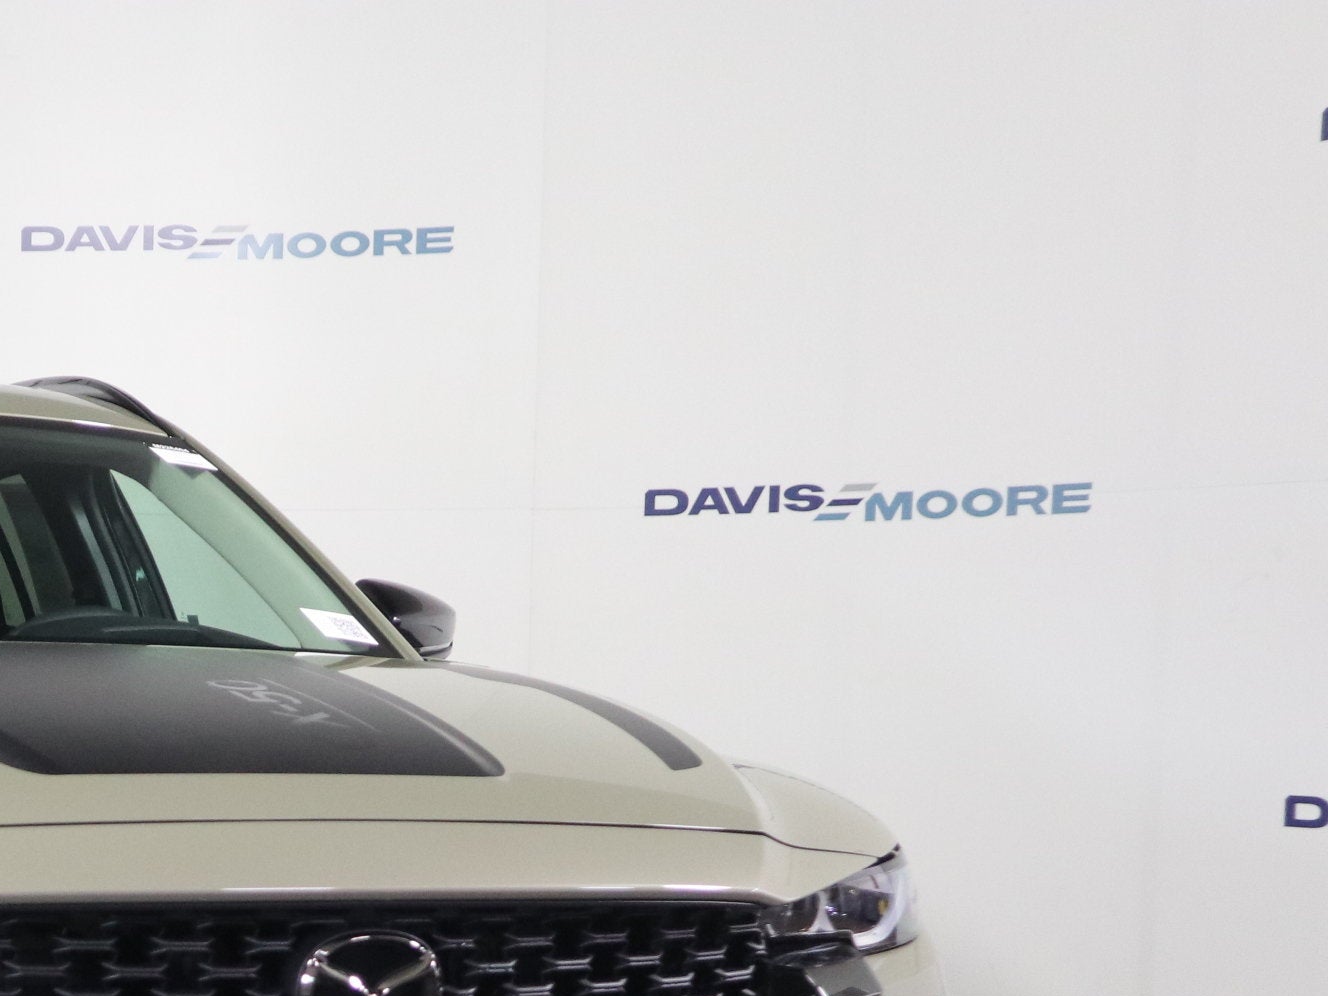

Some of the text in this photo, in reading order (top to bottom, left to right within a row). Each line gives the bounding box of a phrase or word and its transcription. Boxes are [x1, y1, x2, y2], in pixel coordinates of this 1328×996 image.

[20, 224, 455, 260] DAVIS MOORE
[644, 482, 1093, 523] DAVIS MOORE
